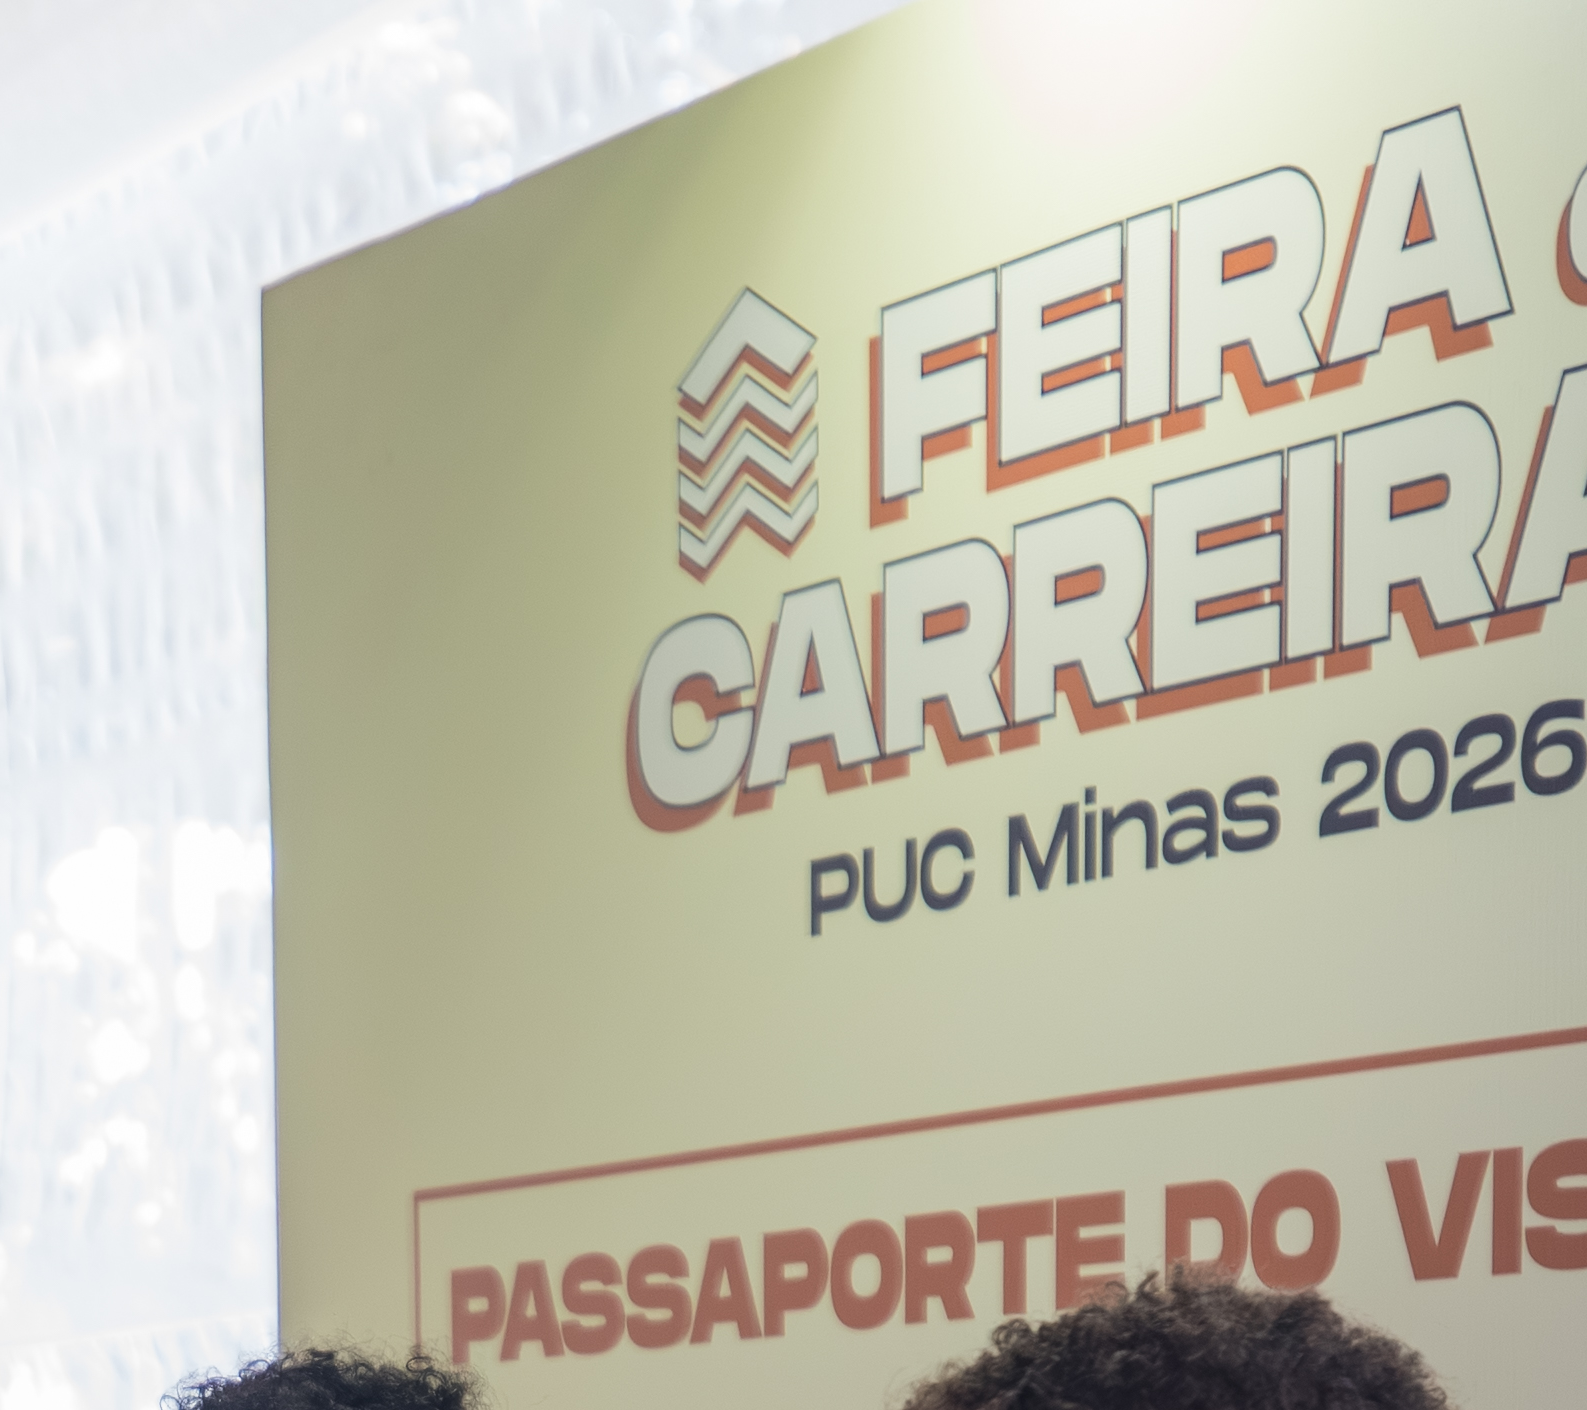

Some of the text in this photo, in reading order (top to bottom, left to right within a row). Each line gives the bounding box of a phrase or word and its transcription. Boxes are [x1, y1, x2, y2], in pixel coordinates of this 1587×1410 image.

[869, 103, 1515, 529] FEIRA
[809, 828, 975, 937] PUC
[1006, 773, 1280, 899] Minas
[450, 1190, 1126, 1366] PASSAPORTE
[1164, 1168, 1341, 1296] DO
